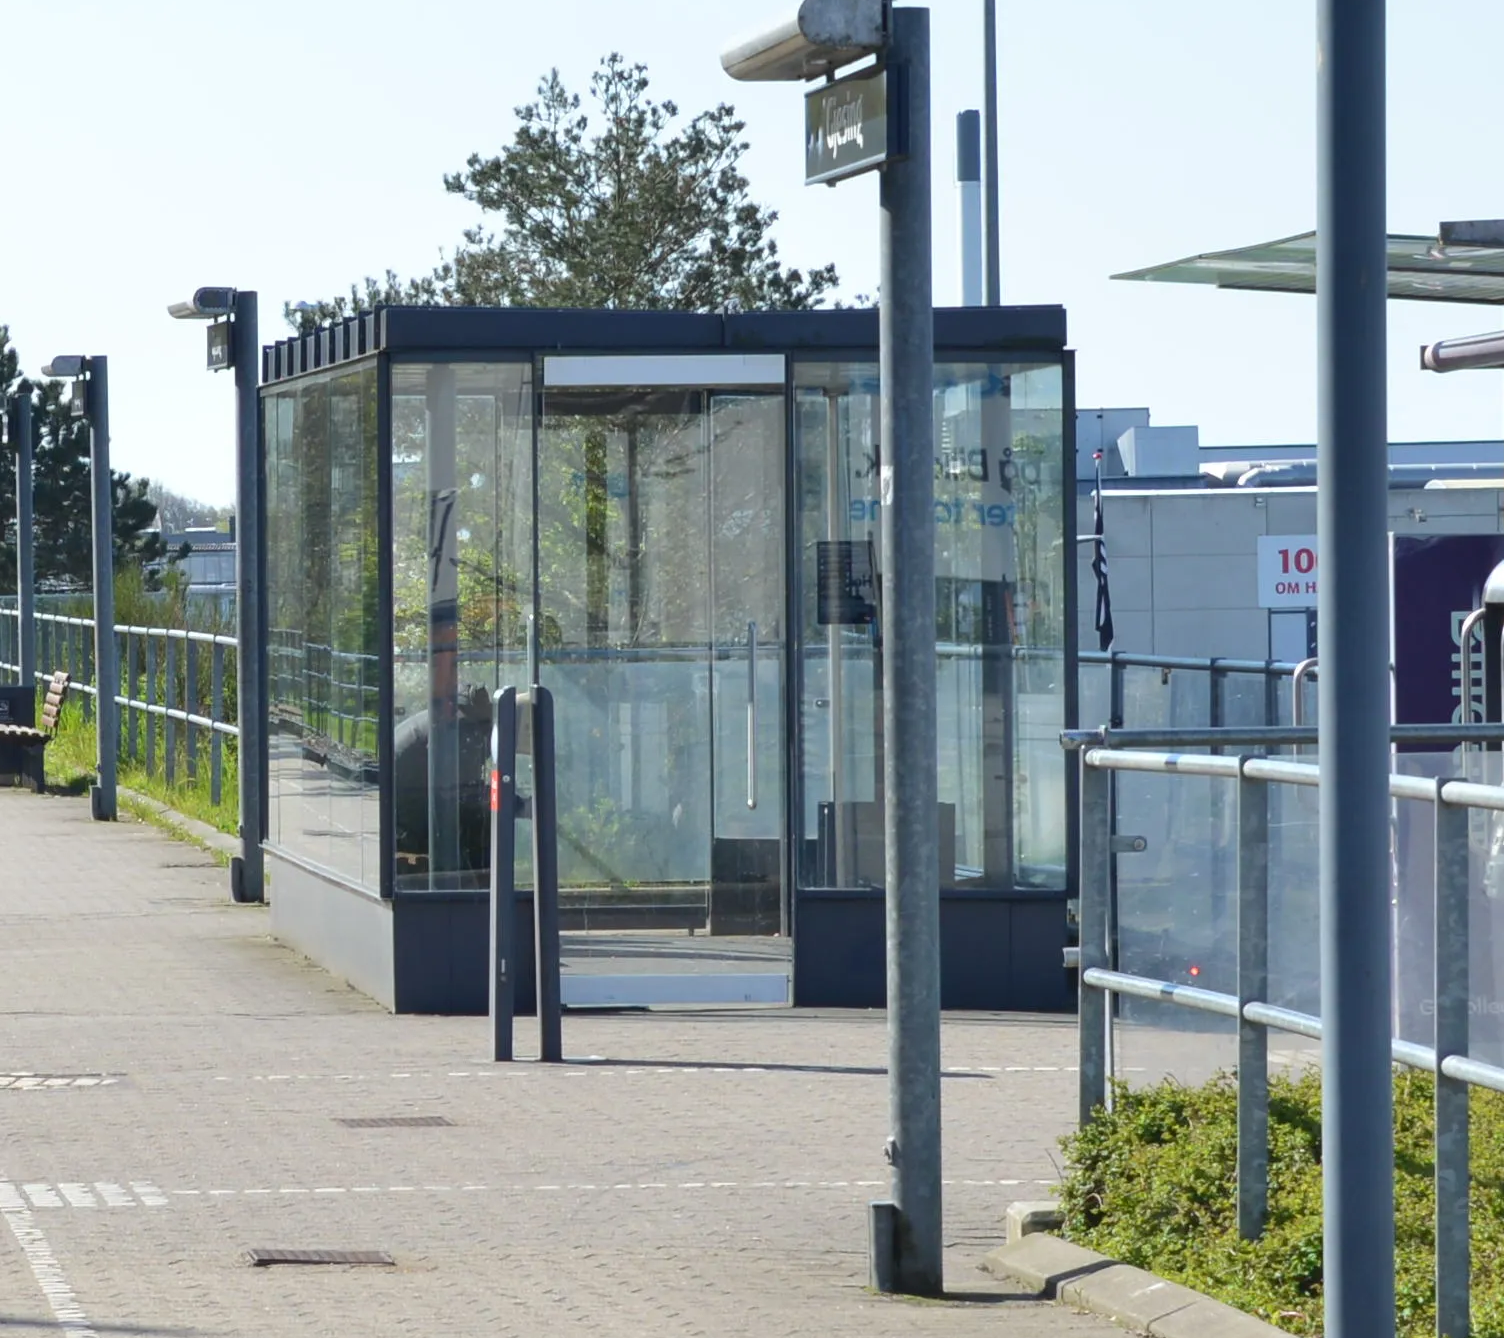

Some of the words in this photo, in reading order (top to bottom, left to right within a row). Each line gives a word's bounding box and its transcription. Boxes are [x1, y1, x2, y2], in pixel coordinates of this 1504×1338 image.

[1278, 548, 1318, 574] 10
[1276, 582, 1300, 595] OM
[1305, 581, 1318, 594] H
